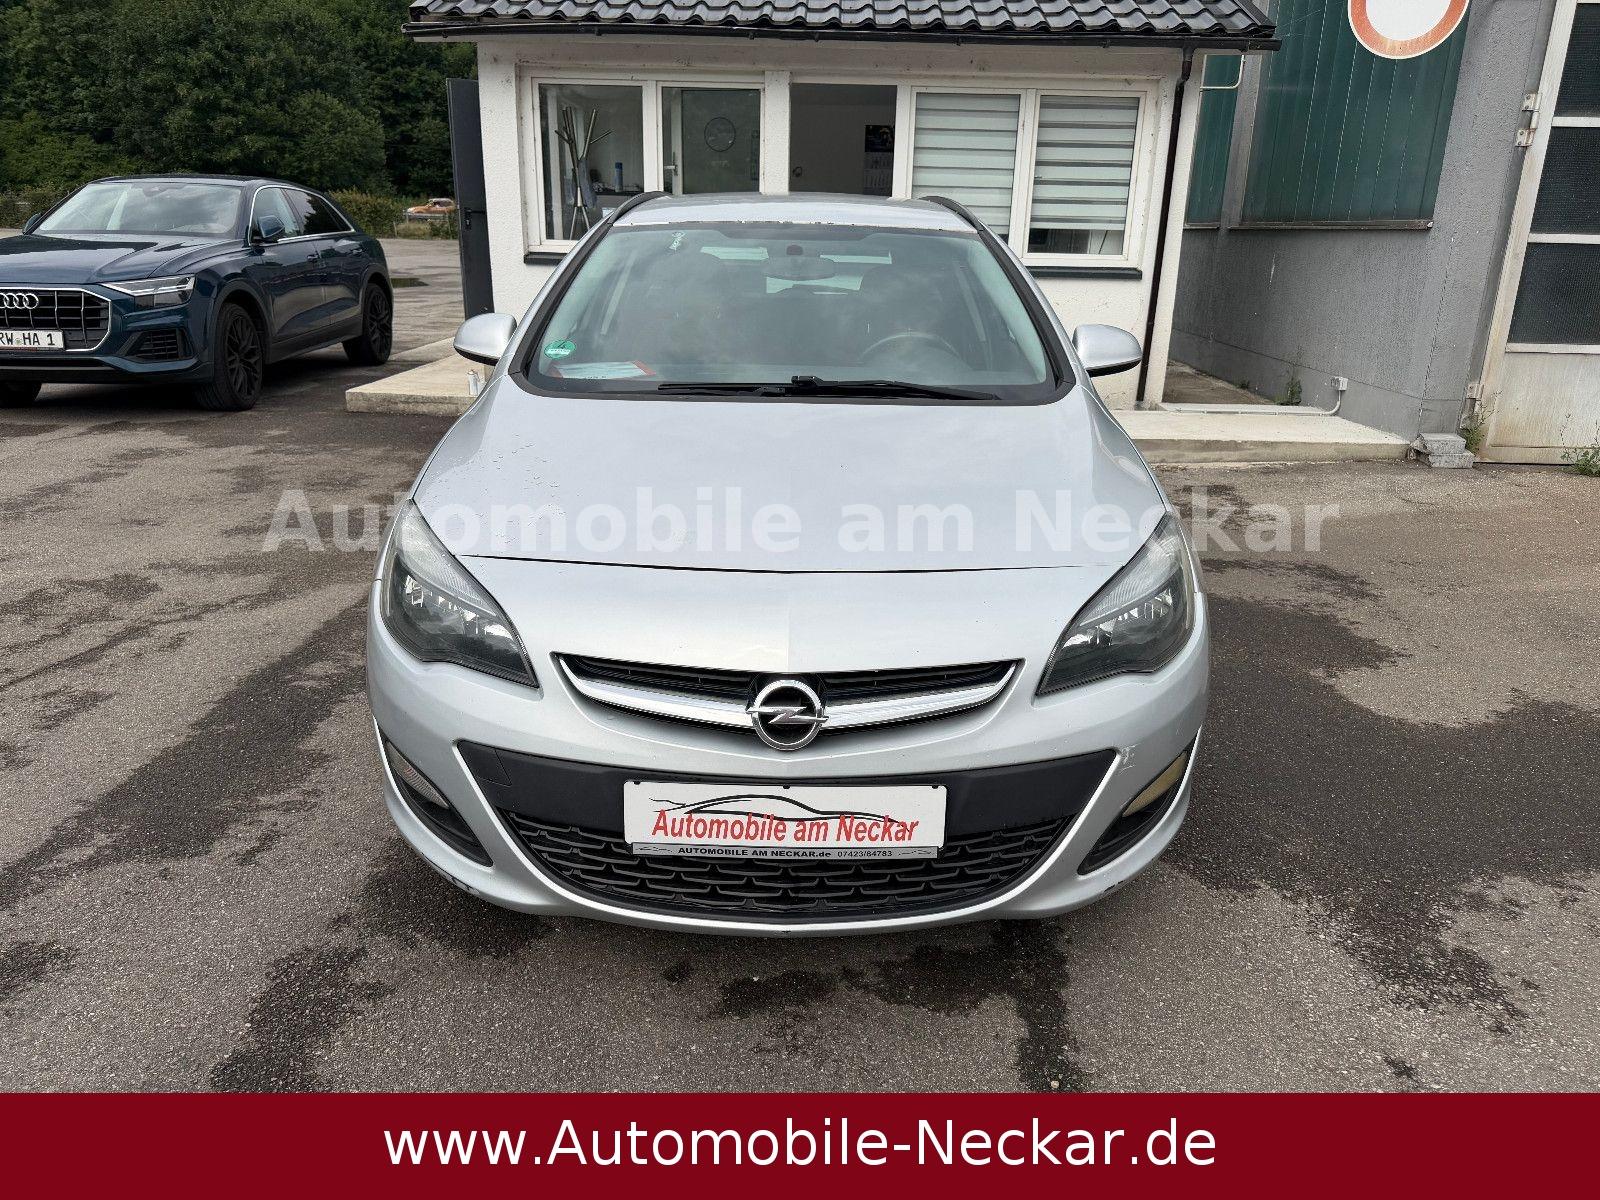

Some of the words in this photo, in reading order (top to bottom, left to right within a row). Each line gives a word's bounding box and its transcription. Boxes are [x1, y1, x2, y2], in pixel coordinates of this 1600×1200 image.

[22, 332, 40, 346] HA
[46, 332, 56, 346] 1
[652, 808, 787, 841] Automobile
[794, 820, 829, 842] am
[835, 814, 920, 842] Neckar
[678, 847, 749, 856] AUTOMOBILE
[751, 849, 768, 857] AM
[770, 849, 832, 858] NECKAR.de
